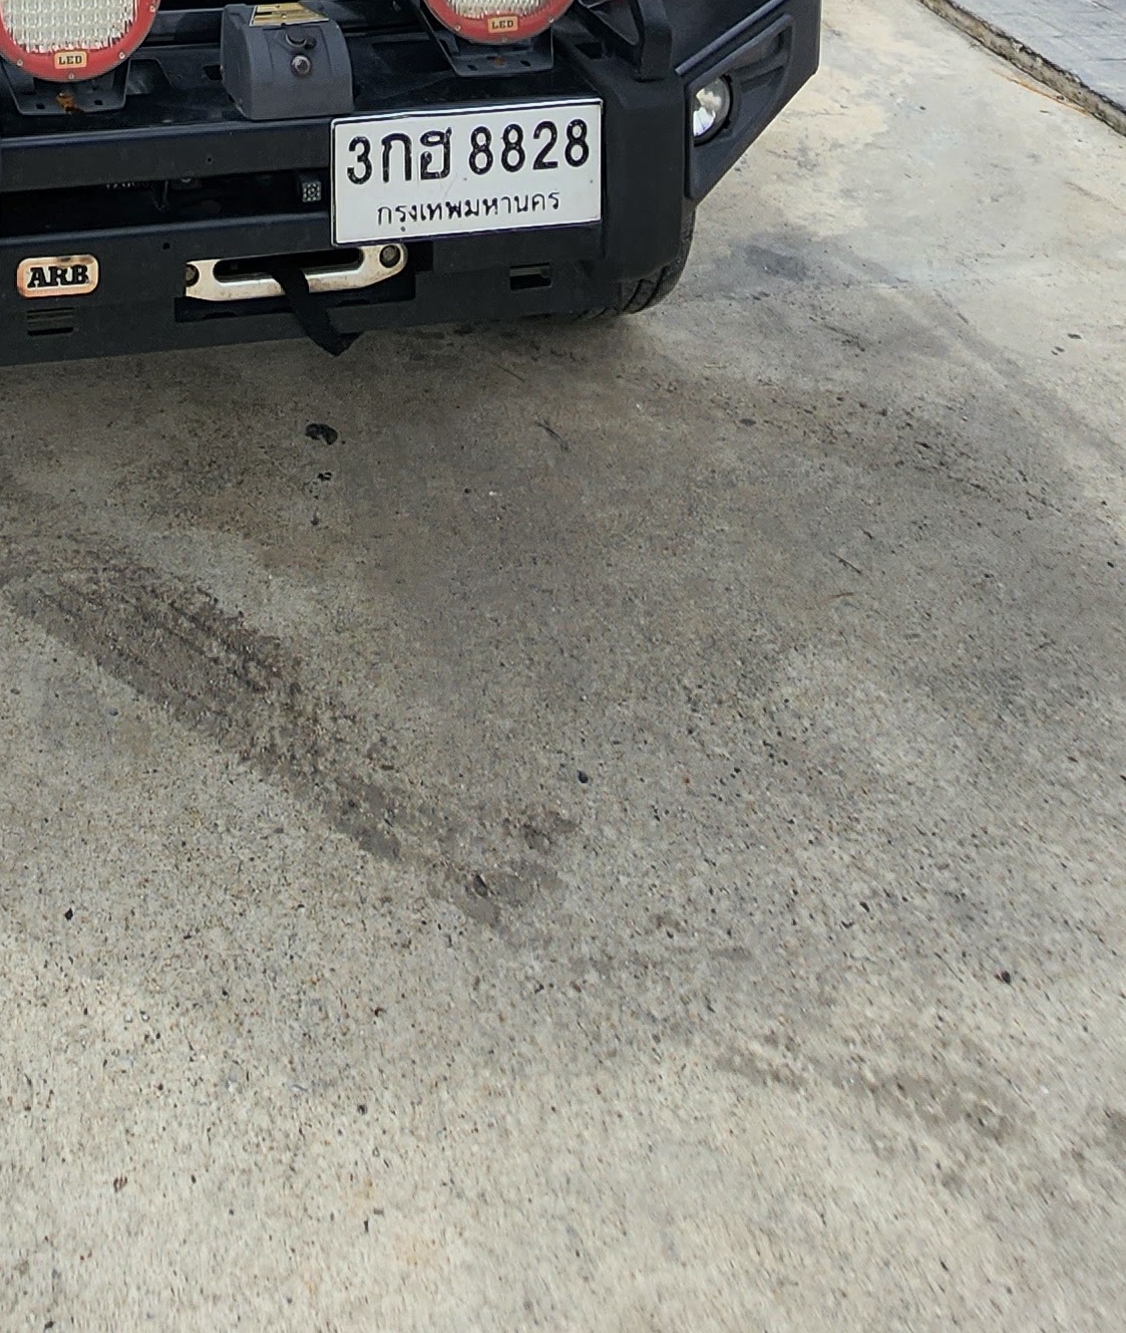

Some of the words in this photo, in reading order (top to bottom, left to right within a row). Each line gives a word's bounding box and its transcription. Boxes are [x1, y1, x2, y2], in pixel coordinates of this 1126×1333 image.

[490, 18, 514, 30] LED
[58, 52, 83, 65] LED
[347, 127, 452, 185] 3กฮ
[468, 118, 591, 176] 8828
[377, 191, 562, 228] กรุงเทพมหานคร
[26, 263, 90, 288] ARB
